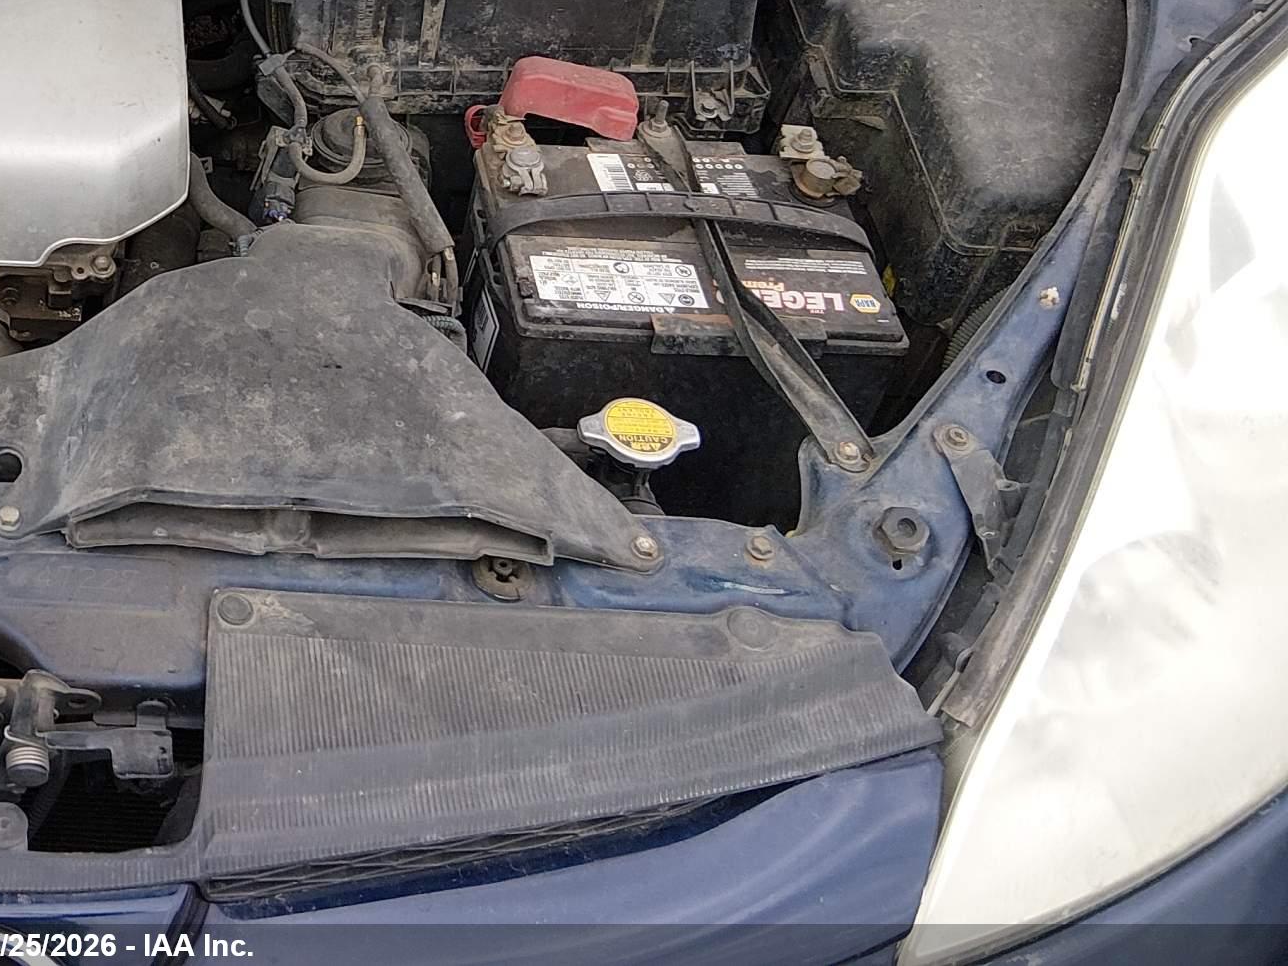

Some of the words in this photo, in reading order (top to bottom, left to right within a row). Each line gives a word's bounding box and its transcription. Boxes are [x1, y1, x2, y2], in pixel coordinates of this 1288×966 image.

[741, 280, 785, 291] Prem
[748, 289, 845, 311] LEGE
[618, 435, 668, 444] CAUTION
